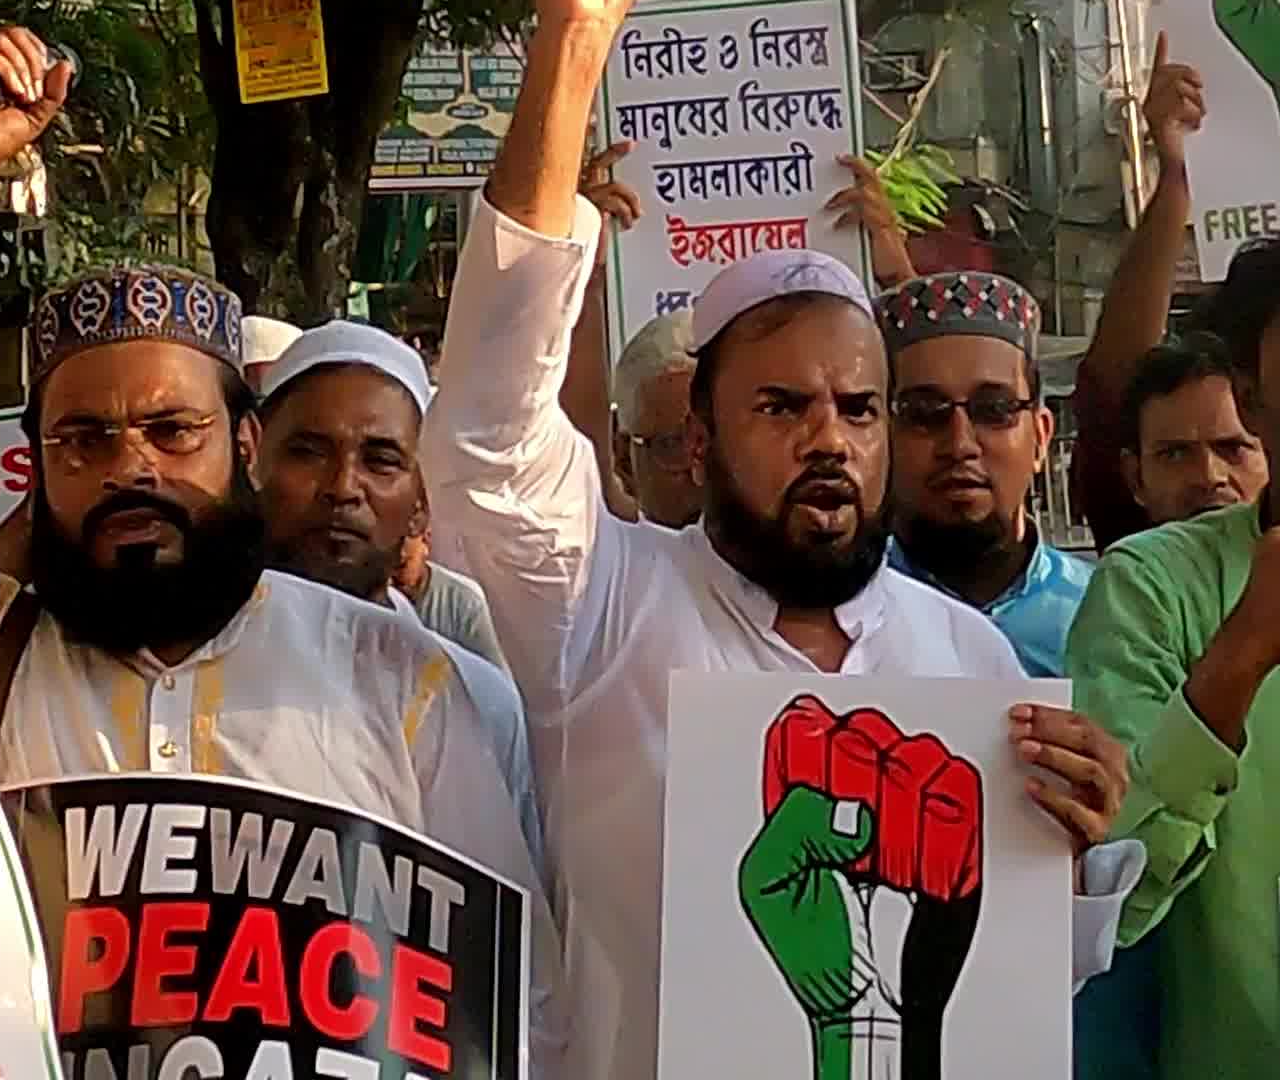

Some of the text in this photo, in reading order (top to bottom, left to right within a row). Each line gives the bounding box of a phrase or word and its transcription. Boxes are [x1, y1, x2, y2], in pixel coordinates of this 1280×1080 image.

[621, 27, 708, 80] নিরীহ
[718, 34, 739, 70] ও
[616, 80, 844, 151] মানুষের বিরুদ্ধে
[651, 141, 814, 204] হামলাকারী
[1203, 204, 1278, 242] FREE
[64, 802, 466, 954] WE WANT
[57, 901, 454, 1073] PEACE
